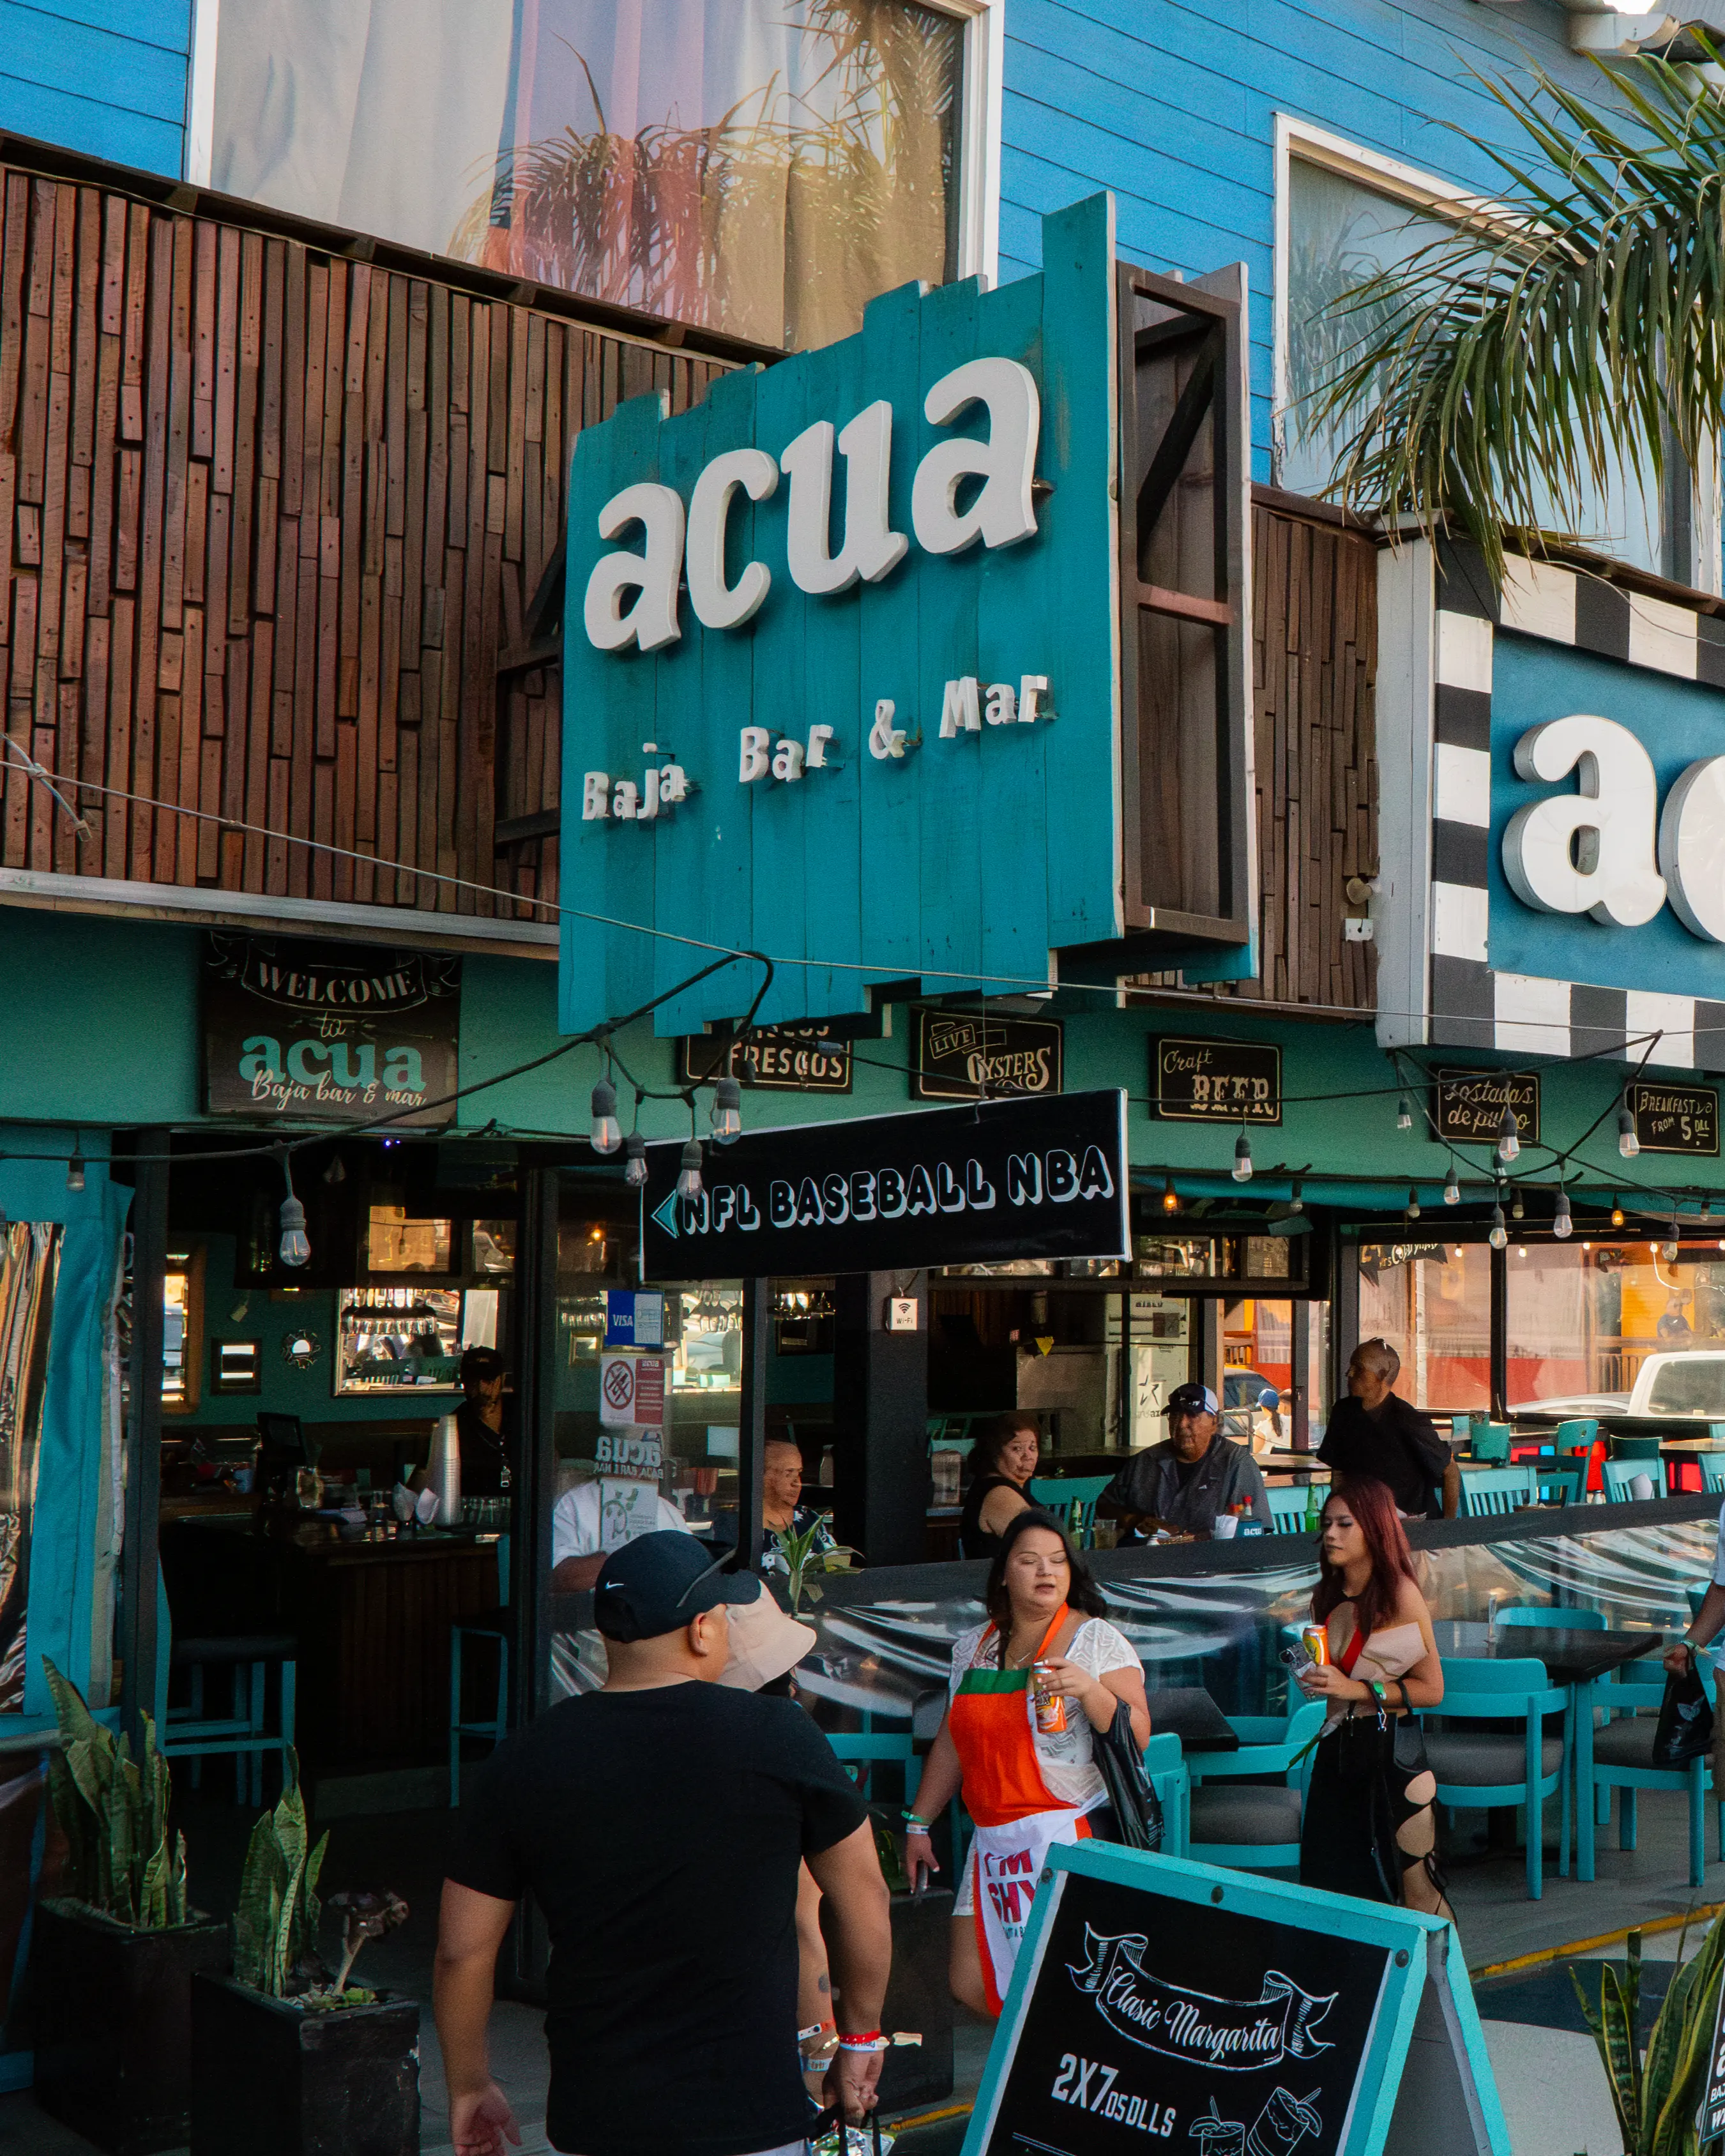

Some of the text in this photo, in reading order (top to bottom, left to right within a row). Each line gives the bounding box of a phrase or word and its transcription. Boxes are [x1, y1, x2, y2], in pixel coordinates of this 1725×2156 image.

[584, 356, 1040, 653] acua
[582, 674, 1048, 820] Baja Bar & Mar
[260, 961, 416, 1003] WELCOME
[321, 1012, 346, 1037] to
[935, 1029, 970, 1053] LIVE
[239, 1035, 426, 1092] acua
[967, 1046, 1051, 1091] OYSTERS
[1164, 1049, 1213, 1074] Craft
[251, 1069, 427, 1111] Baja bar & mar
[1190, 1074, 1273, 1116] BEER
[1639, 1091, 1696, 1114] BREAKFAST
[1448, 1104, 1531, 1133] de pulo
[1652, 1116, 1675, 1135] FROM
[1680, 1116, 1692, 1141] 5
[683, 1146, 1114, 1234] NFL BASEBALL NBA
[612, 1314, 634, 1326] VISA
[984, 1848, 1033, 1877] I'M
[1107, 1966, 1284, 2061] Clasic Margarita
